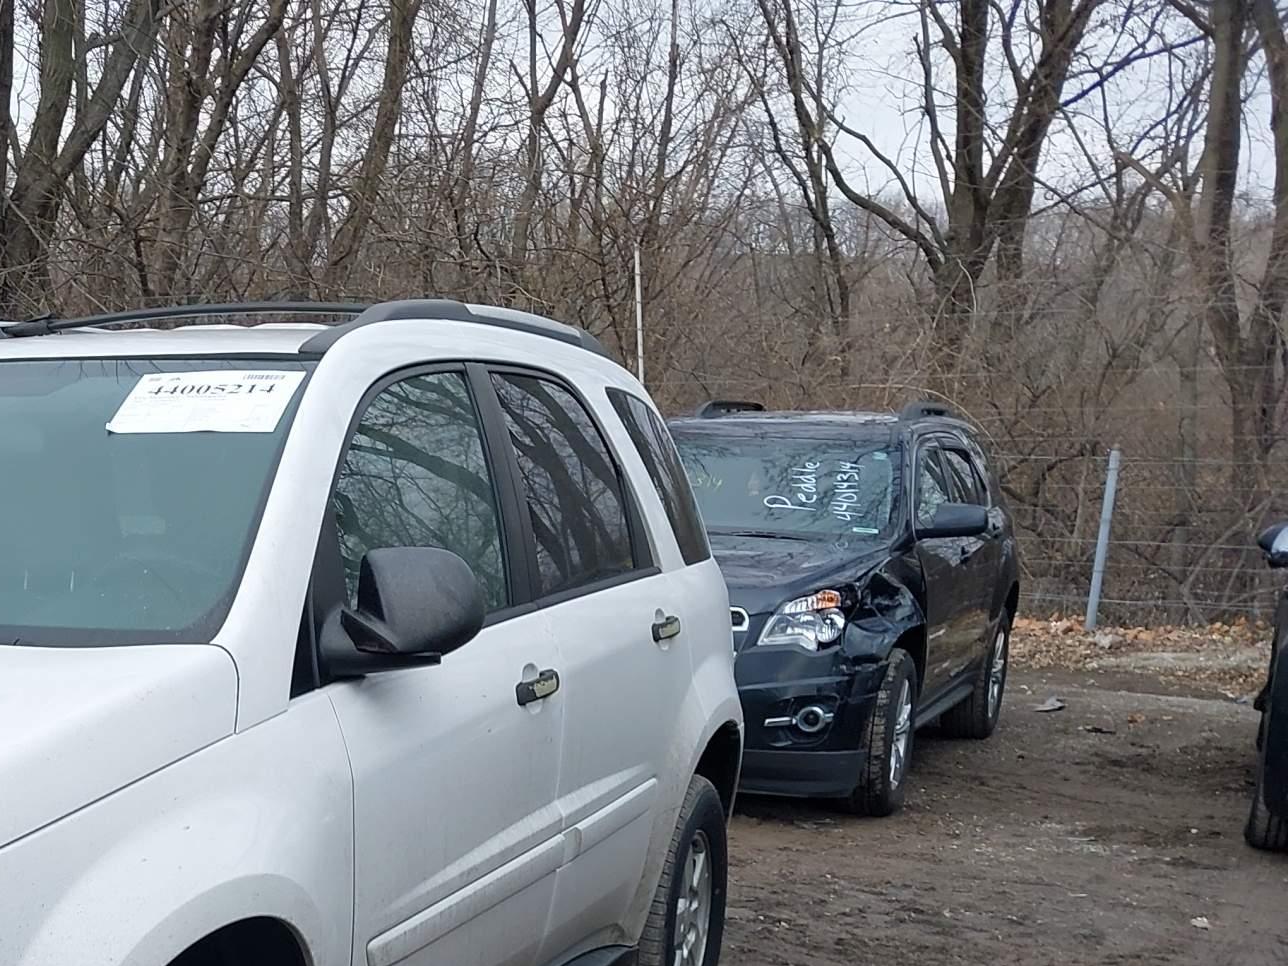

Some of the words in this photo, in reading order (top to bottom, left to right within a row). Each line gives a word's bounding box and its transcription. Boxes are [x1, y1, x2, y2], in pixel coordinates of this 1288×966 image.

[147, 382, 276, 396] 44005214
[763, 460, 821, 512] Peddle
[830, 461, 865, 522] 44014314
